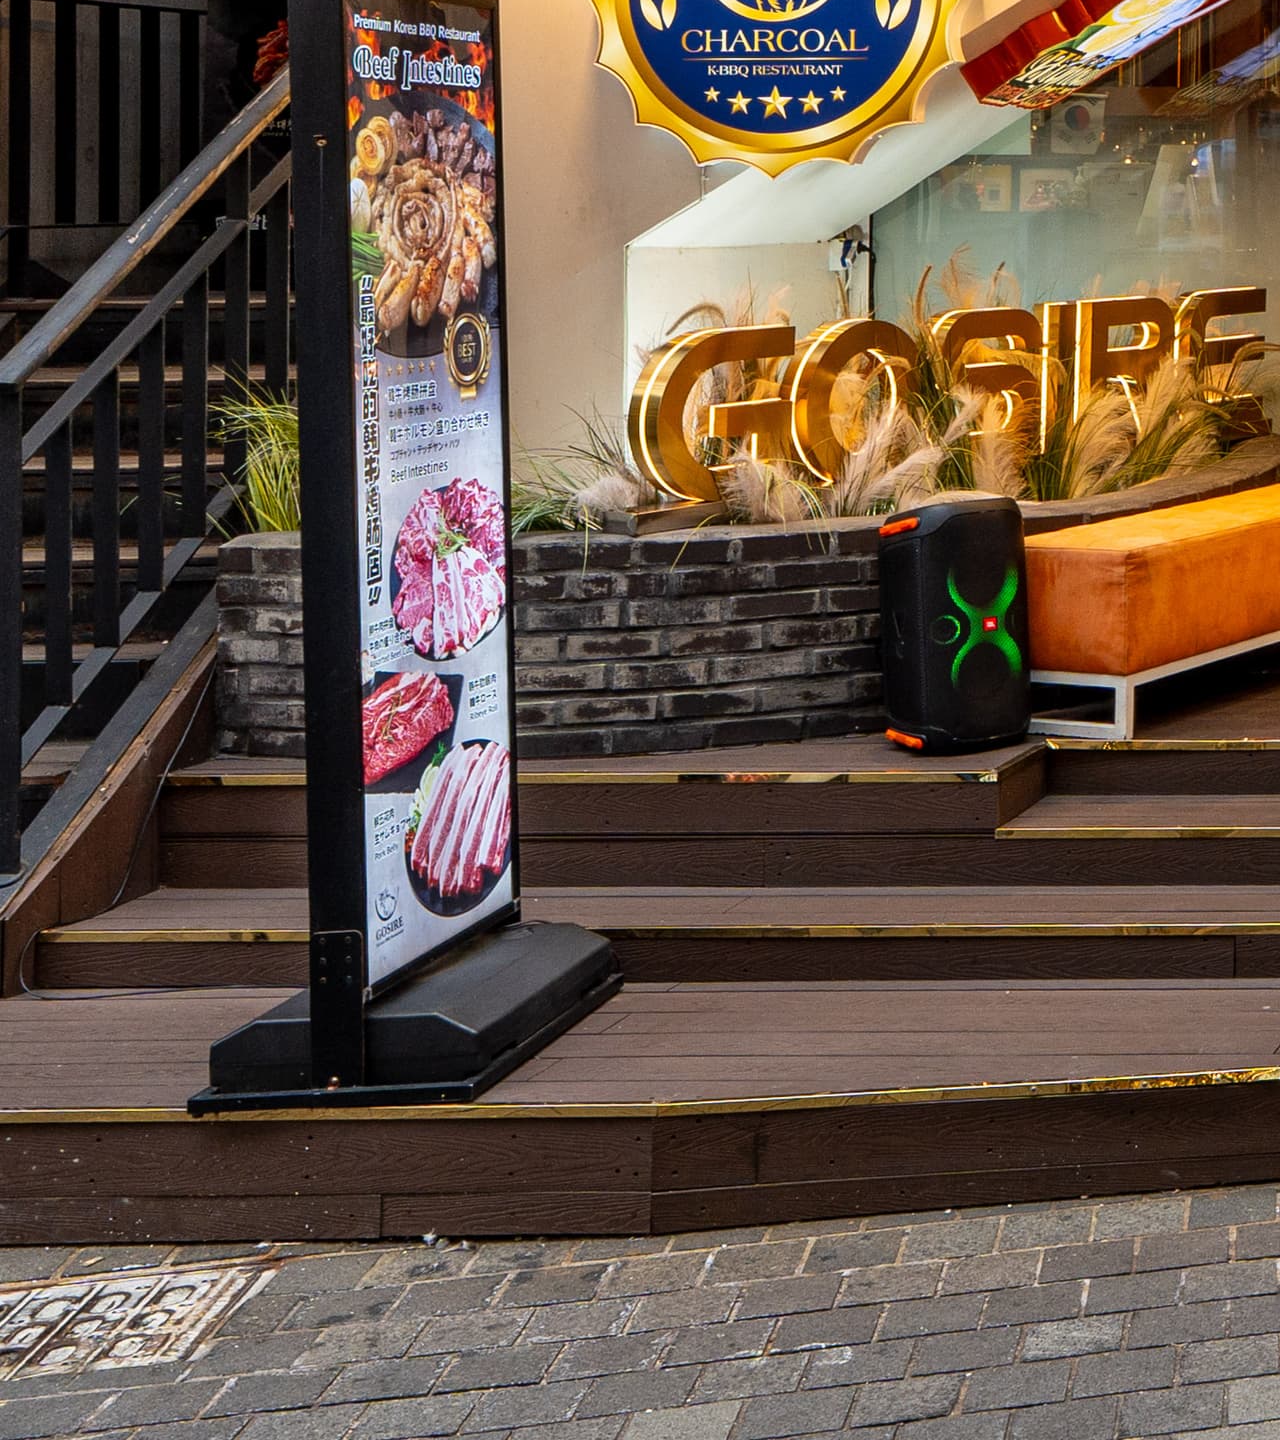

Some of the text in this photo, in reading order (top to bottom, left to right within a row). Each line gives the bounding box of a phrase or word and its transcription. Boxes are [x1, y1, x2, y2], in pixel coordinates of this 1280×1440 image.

[354, 13, 481, 43] Premium Korea BBQ Restaurant
[681, 28, 870, 54] CHARCOAL
[353, 45, 482, 91] Beef Intestines
[707, 63, 844, 78] K-BBQ RESTAURANT
[628, 287, 1273, 502] GOSIRE
[391, 460, 449, 483] Beef Intestines
[375, 915, 404, 941] GOSIRE
